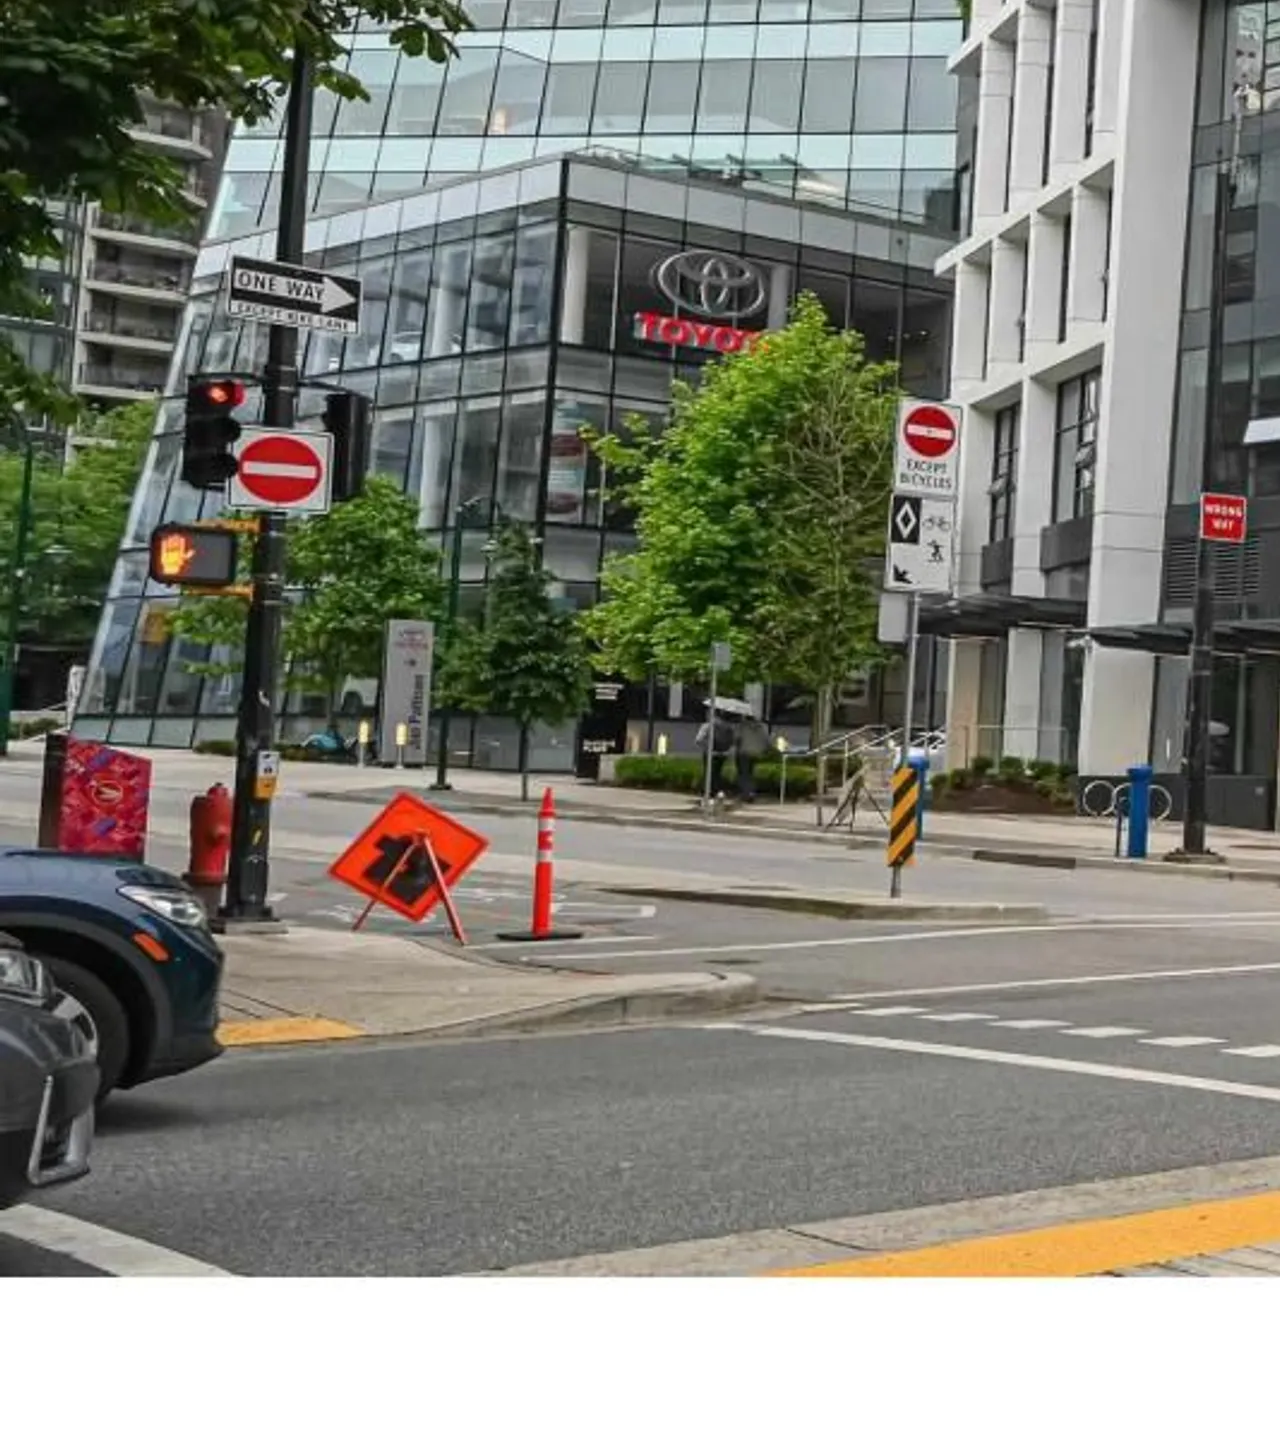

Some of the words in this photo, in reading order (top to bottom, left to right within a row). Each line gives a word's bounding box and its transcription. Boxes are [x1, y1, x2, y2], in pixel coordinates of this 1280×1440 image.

[238, 271, 277, 291] ONE
[286, 280, 325, 300] WAY
[634, 311, 769, 356] TOYO
[907, 459, 947, 474] EXCEPT
